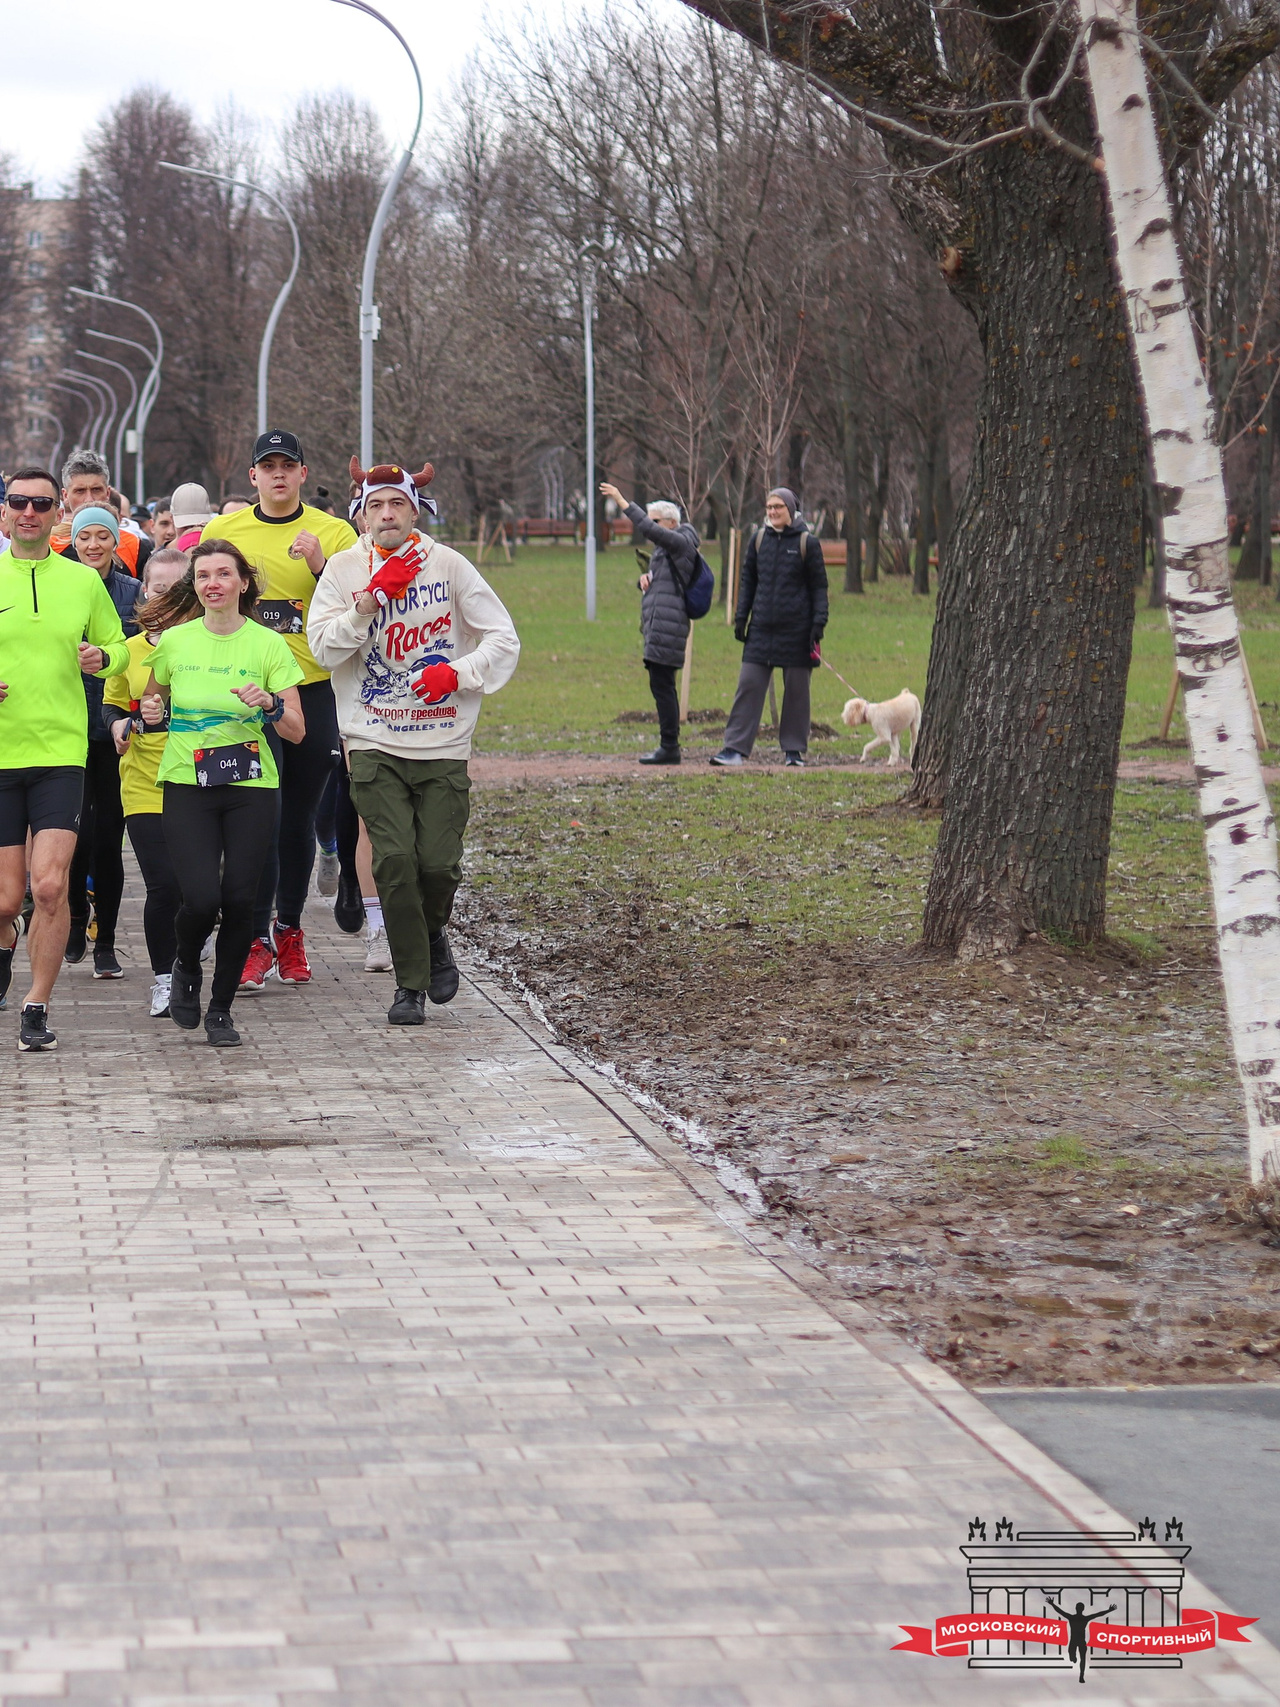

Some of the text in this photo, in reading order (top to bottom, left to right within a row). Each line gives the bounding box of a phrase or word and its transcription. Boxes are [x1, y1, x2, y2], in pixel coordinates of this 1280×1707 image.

[263, 611, 280, 620] 019
[385, 611, 451, 662] Races
[411, 705, 458, 722] speedway
[387, 723, 436, 732] ANGELES
[439, 721, 455, 729] US
[220, 758, 238, 769] 044
